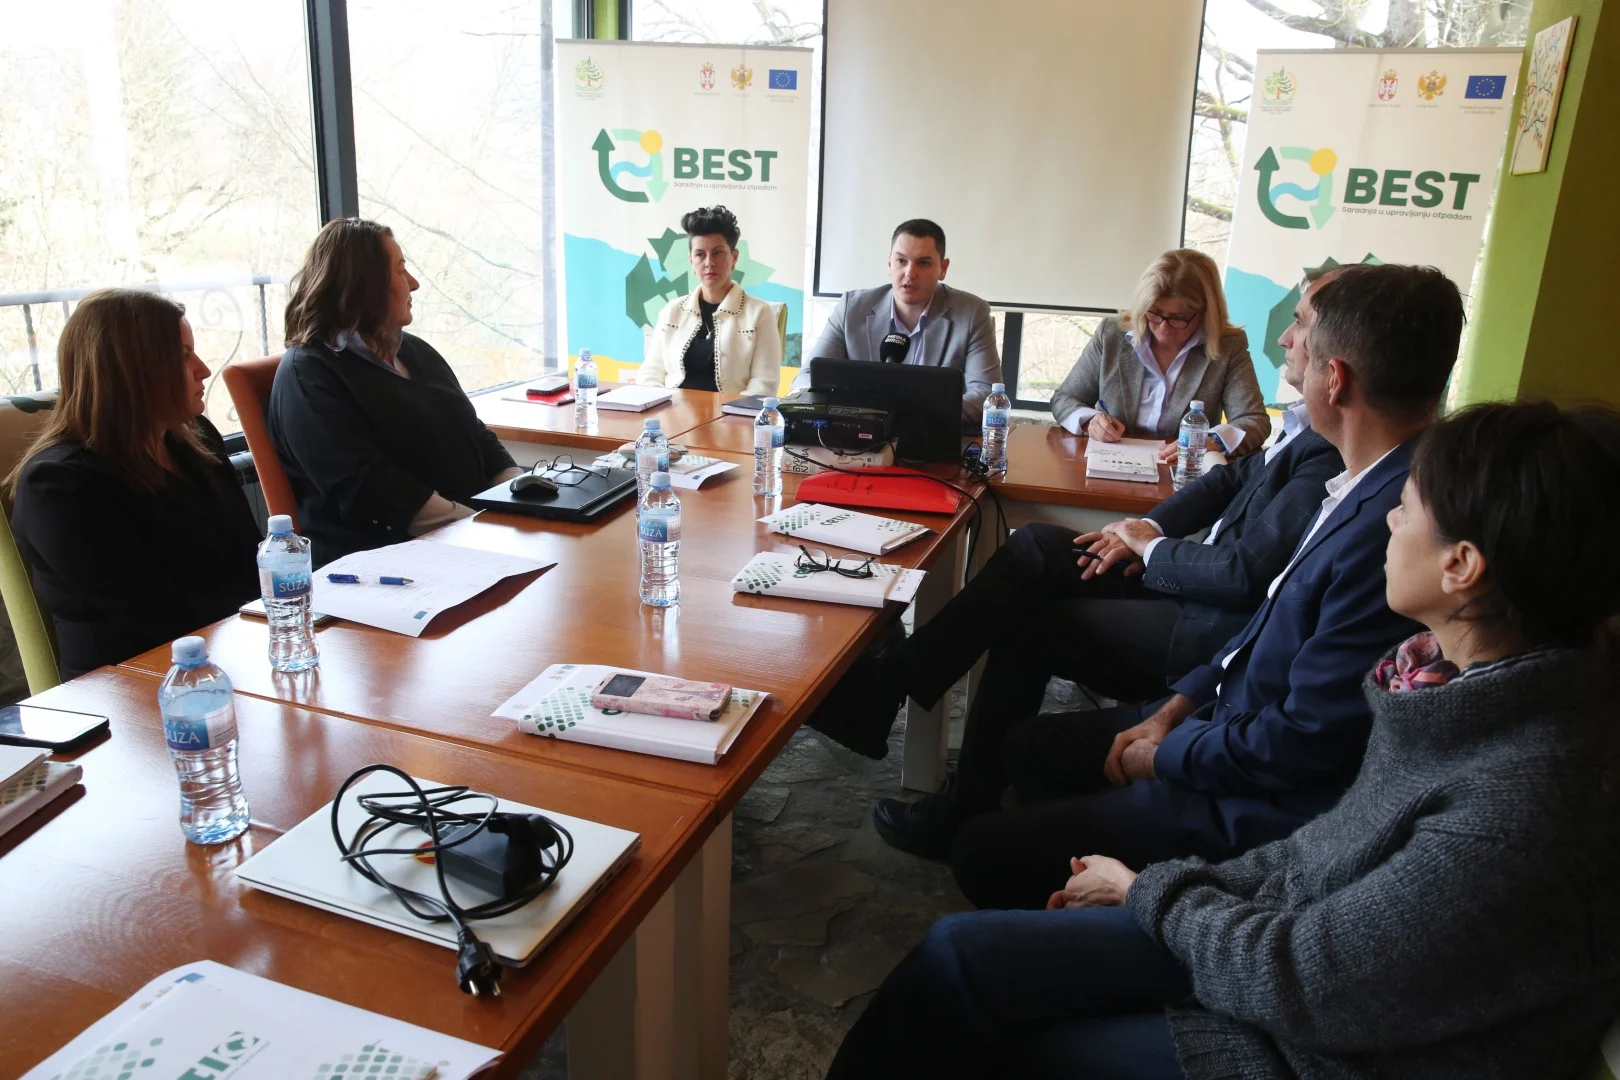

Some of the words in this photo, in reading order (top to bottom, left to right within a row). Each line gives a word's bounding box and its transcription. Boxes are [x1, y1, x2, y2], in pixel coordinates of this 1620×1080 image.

[673, 147, 778, 182] BEST
[673, 181, 703, 190] Saradnja
[709, 182, 746, 191] upravljanju
[1343, 167, 1481, 210] BEST
[1341, 206, 1377, 215] Saradnja
[1385, 209, 1431, 219] upravljanju
[1432, 212, 1472, 221] otpadom
[987, 417, 1006, 425] SUZA
[279, 578, 309, 593] SUZA
